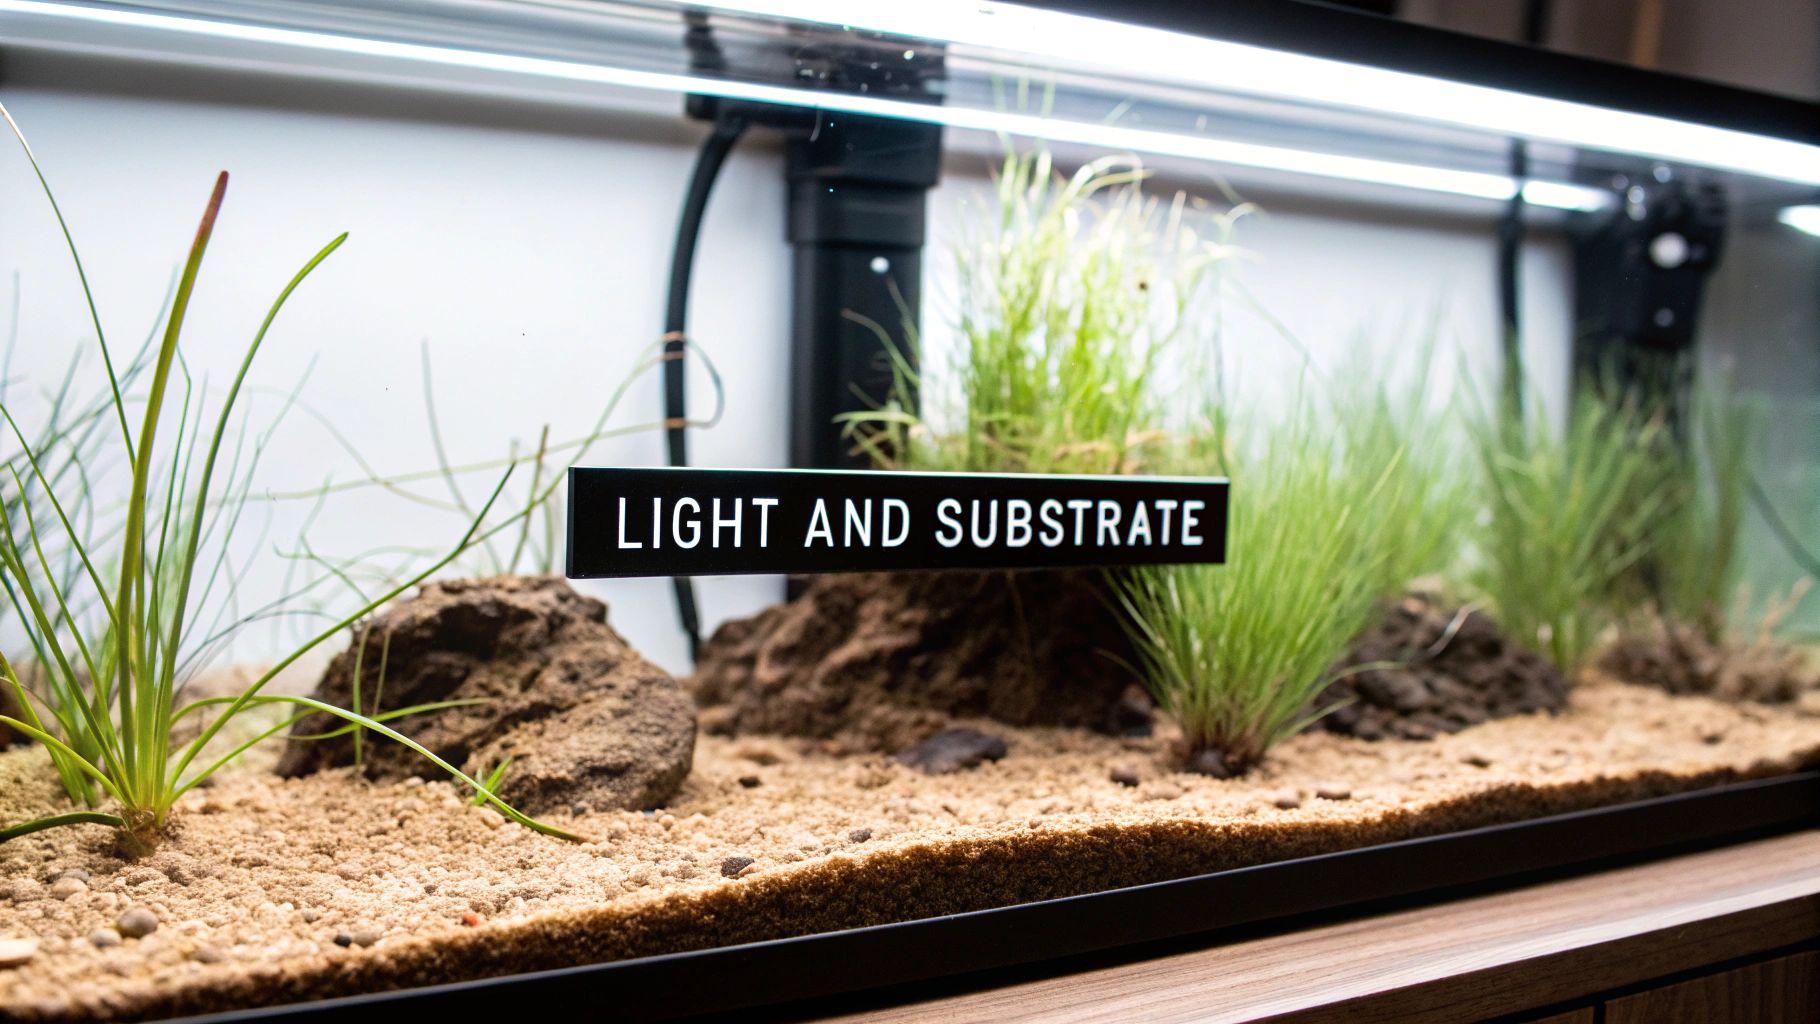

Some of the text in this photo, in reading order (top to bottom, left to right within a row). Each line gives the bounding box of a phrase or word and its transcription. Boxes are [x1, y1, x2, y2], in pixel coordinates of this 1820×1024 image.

[617, 497, 1205, 549] LIGHT AND SUBSTRATE
